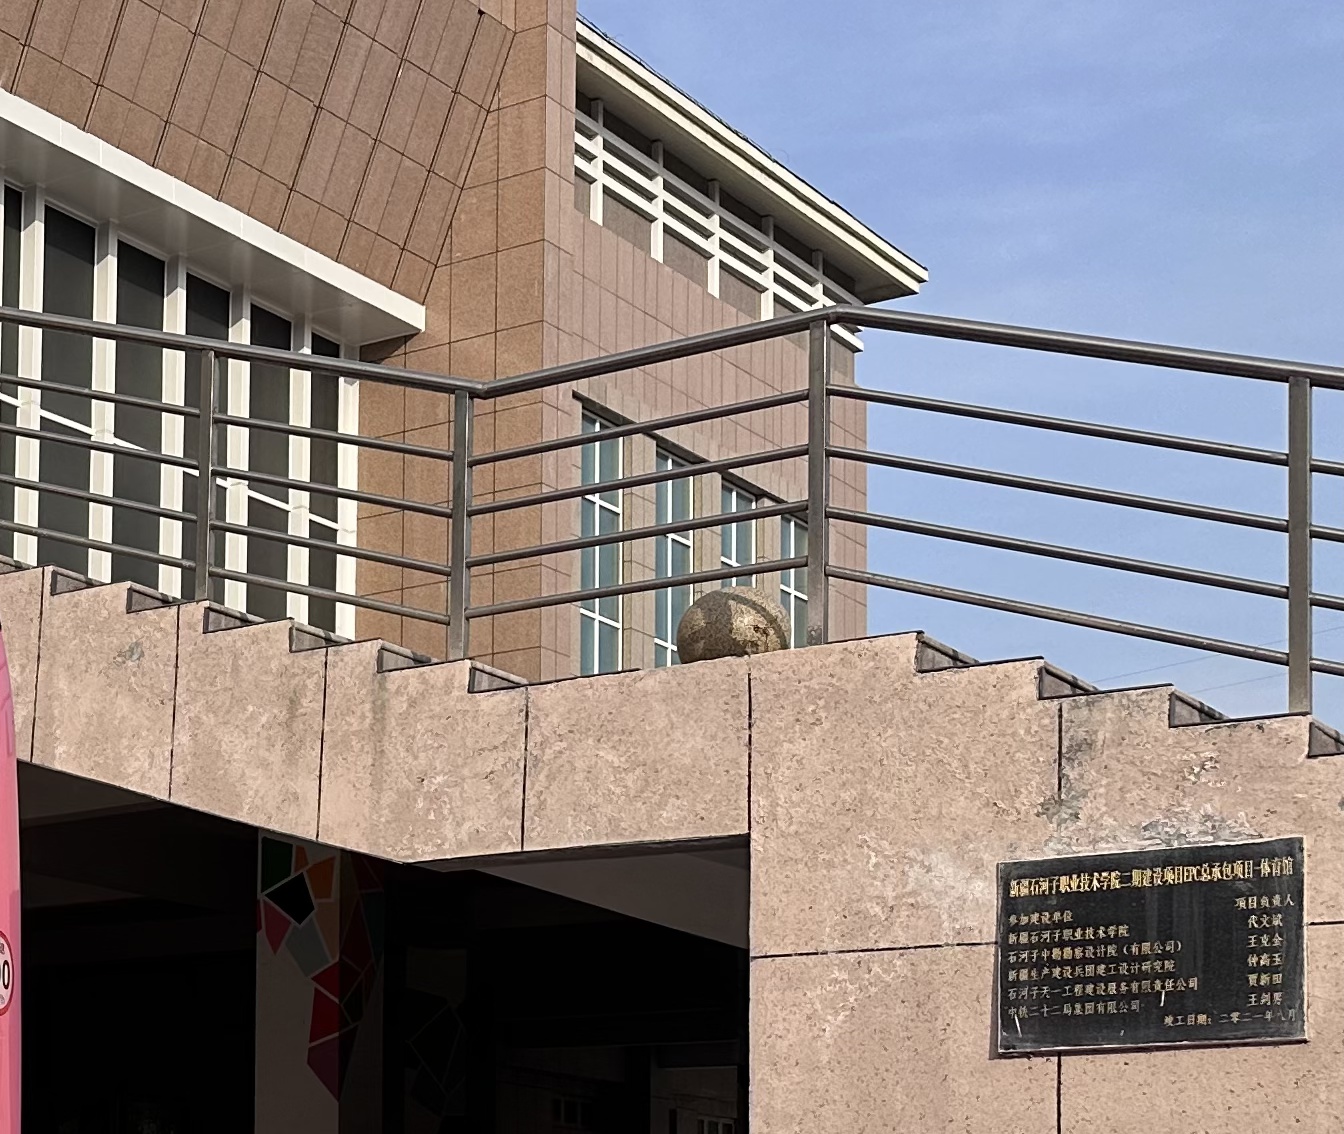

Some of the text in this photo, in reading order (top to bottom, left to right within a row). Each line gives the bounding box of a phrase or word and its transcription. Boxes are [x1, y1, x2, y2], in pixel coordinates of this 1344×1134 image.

[1008, 924, 1130, 945] 新疆石河子职业技术学院
